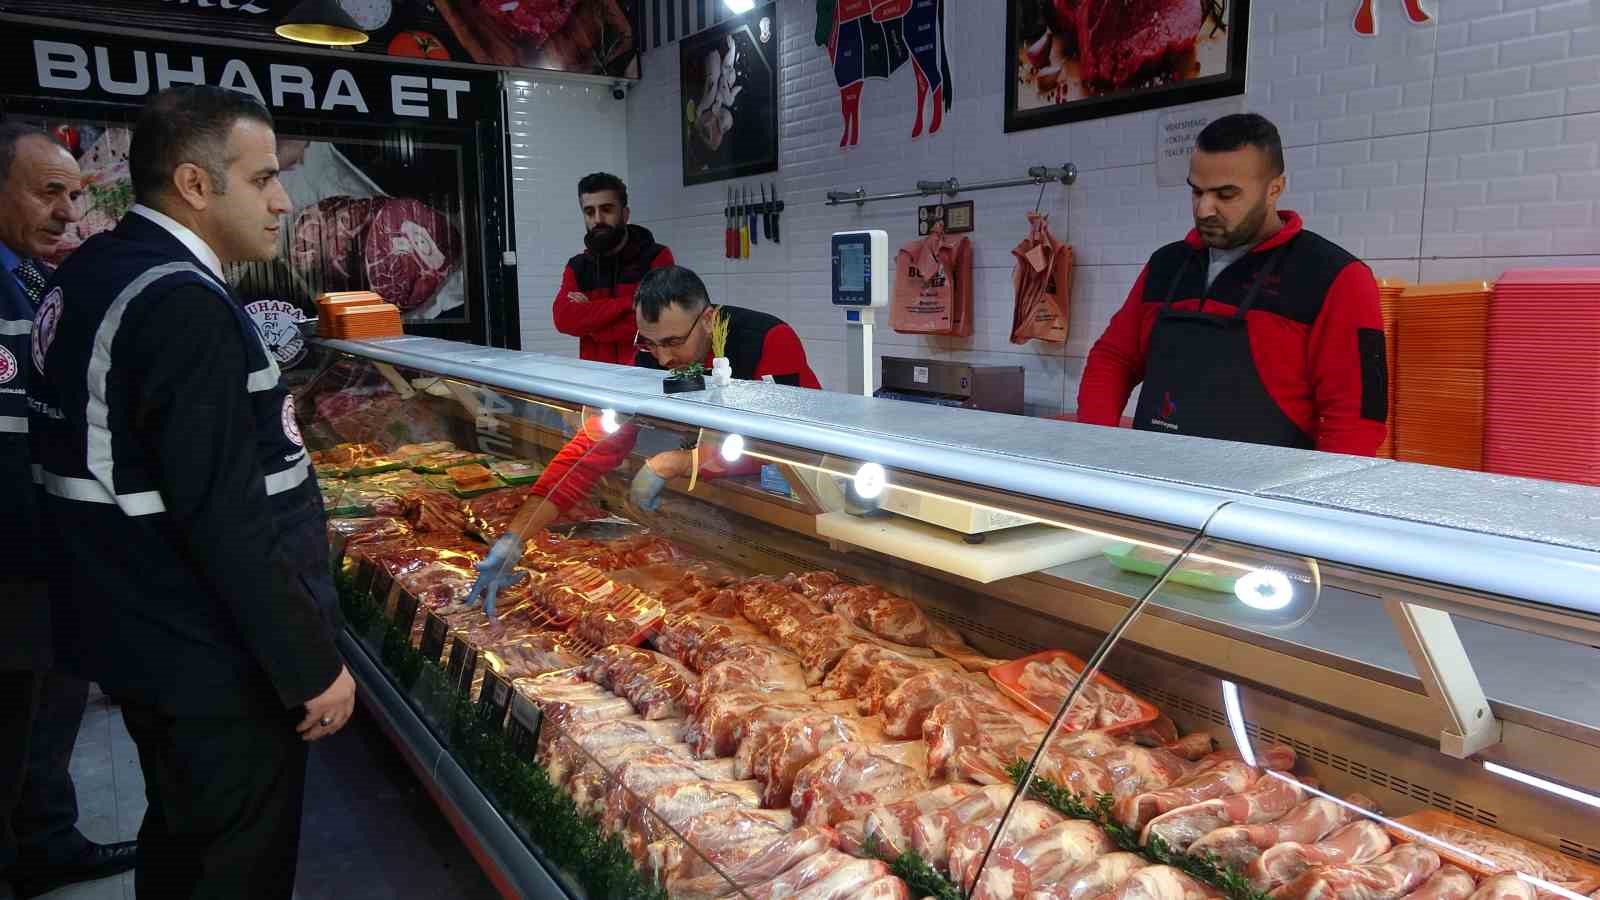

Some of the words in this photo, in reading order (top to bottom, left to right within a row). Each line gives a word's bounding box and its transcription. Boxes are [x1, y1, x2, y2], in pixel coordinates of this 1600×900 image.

[33, 40, 369, 113] BUHARA
[390, 75, 471, 119] ET
[247, 302, 302, 321] UHARA
[264, 312, 280, 321] ET
